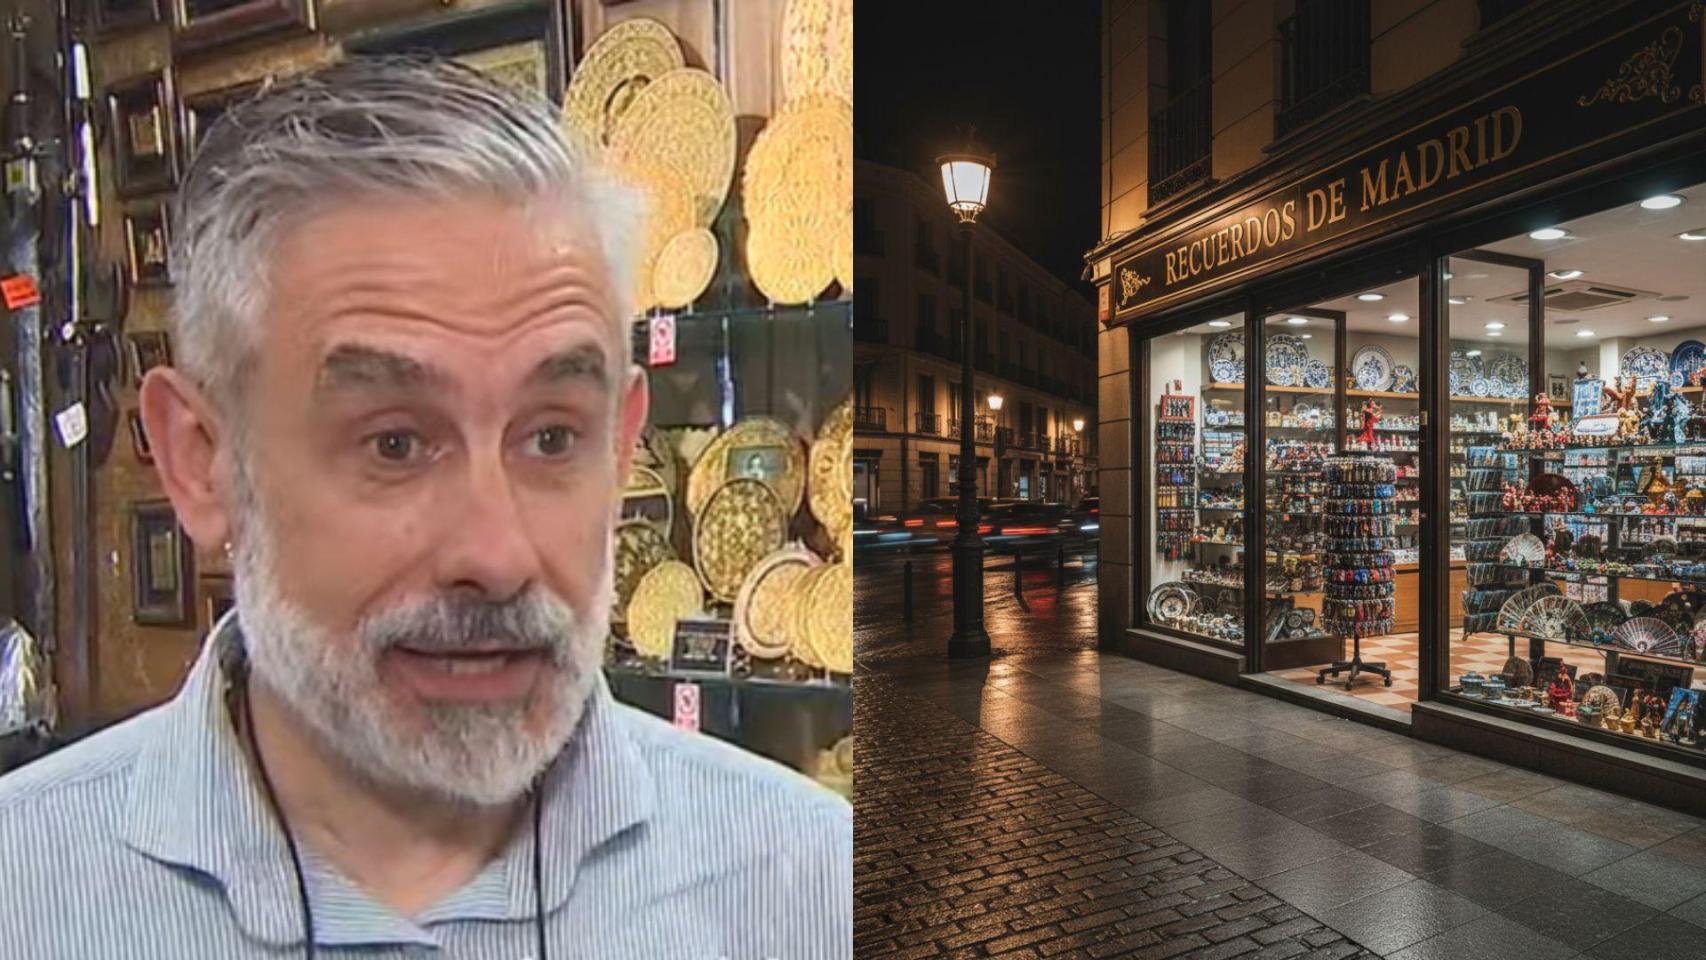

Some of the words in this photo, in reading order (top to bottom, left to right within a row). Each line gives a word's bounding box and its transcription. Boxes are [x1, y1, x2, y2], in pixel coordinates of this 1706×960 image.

[1165, 201, 1296, 286] RECUERDOS
[1306, 181, 1347, 233] DE
[1360, 106, 1523, 212] MADRID
